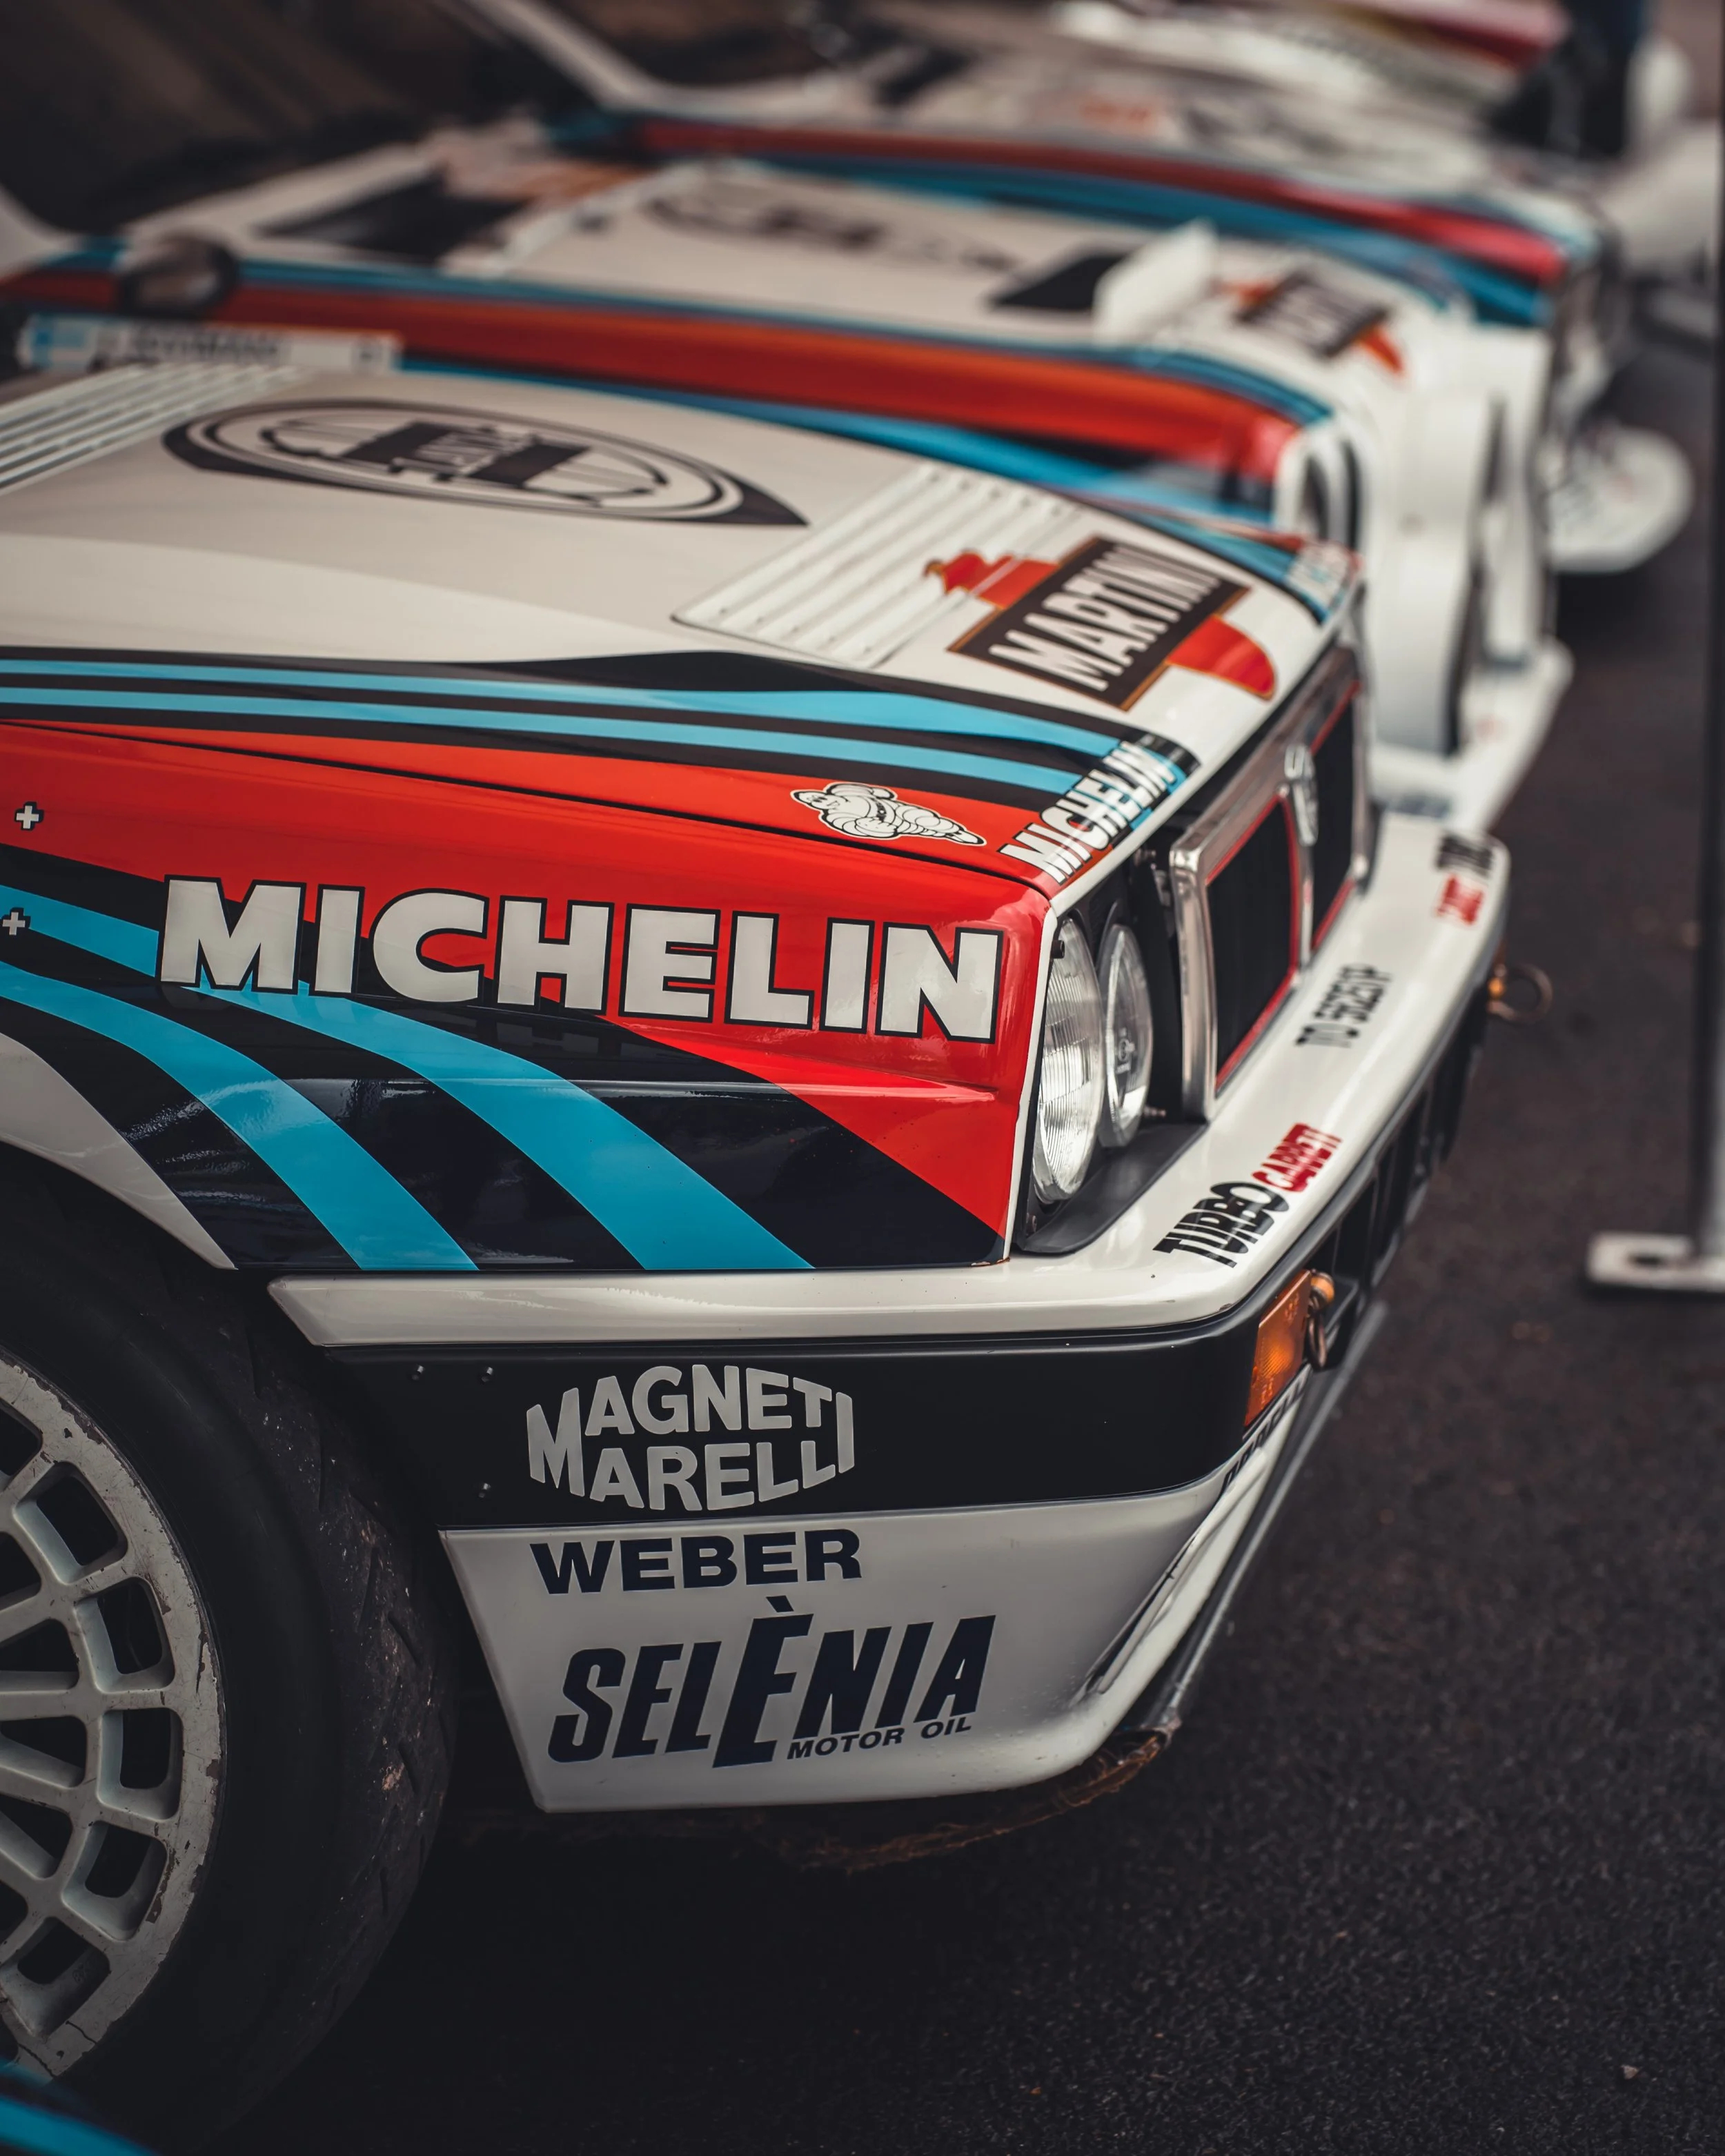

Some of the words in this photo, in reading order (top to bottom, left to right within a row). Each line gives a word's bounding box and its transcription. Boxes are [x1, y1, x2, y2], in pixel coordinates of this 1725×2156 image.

[988, 543, 1221, 691] MARTINI
[998, 740, 1176, 886] MICHELIN
[157, 875, 1003, 1045] MICHELIN
[1152, 1180, 1289, 1268] TURBO
[526, 1364, 855, 1496] MAGNETI
[526, 1387, 855, 1511] MARELLI
[529, 1528, 862, 1594] WEBER
[547, 1596, 996, 1768] SELÈNIA
[787, 1729, 903, 1760] MOTOR
[920, 1717, 972, 1741] OIL
